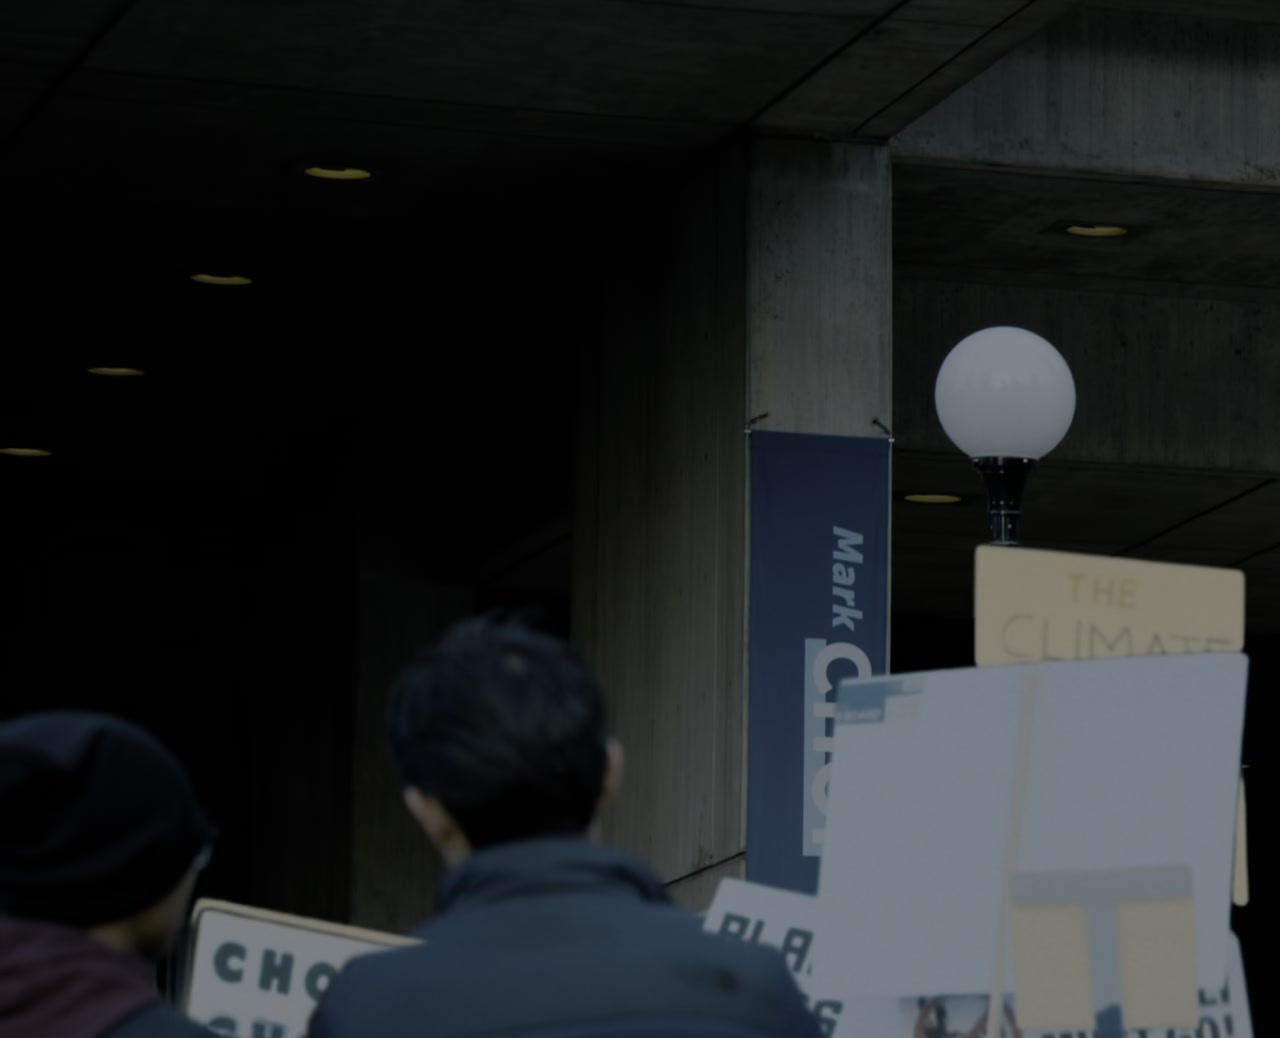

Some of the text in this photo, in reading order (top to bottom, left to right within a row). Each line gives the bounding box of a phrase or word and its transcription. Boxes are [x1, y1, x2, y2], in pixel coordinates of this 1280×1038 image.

[831, 524, 865, 633] Mark
[1067, 571, 1138, 610] THE
[213, 939, 337, 1001] CHO
